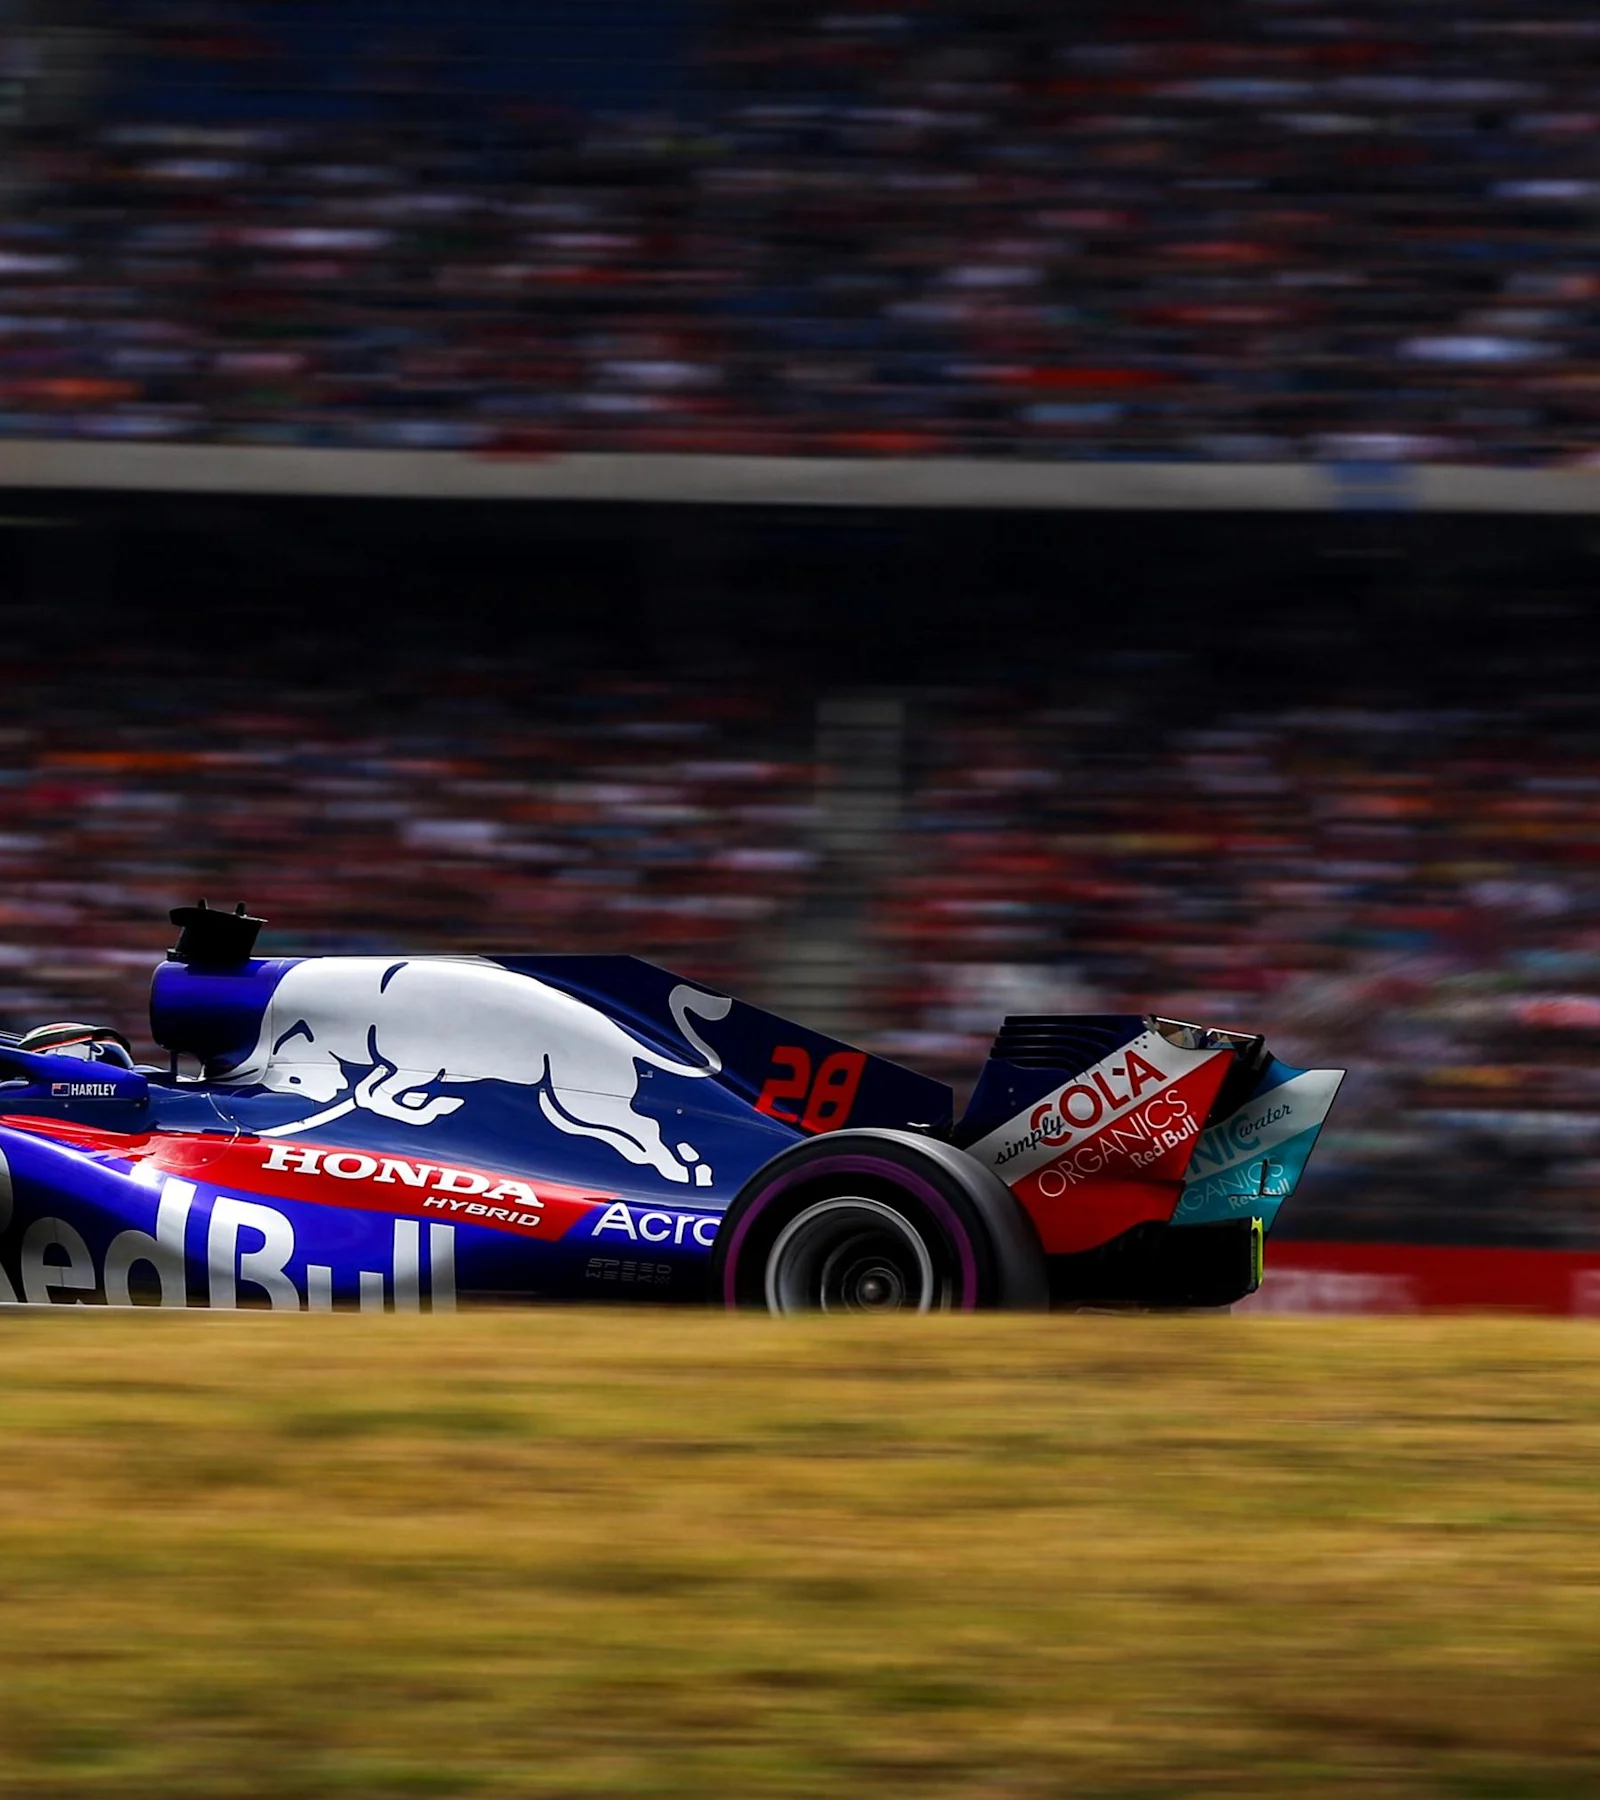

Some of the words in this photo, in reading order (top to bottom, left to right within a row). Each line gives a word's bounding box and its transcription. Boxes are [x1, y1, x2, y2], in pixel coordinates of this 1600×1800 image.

[71, 1083, 117, 1096] HARTLEY
[754, 1046, 867, 1134] 28
[994, 1115, 1064, 1165] simply
[1038, 1089, 1188, 1198] ORGANICS
[1130, 1138, 1166, 1169] Red
[1161, 1114, 1200, 1149] Bull
[1239, 1103, 1293, 1139] water
[261, 1144, 545, 1208] HONDA
[423, 1196, 541, 1227] HYBRID
[590, 1201, 721, 1247] Acro
